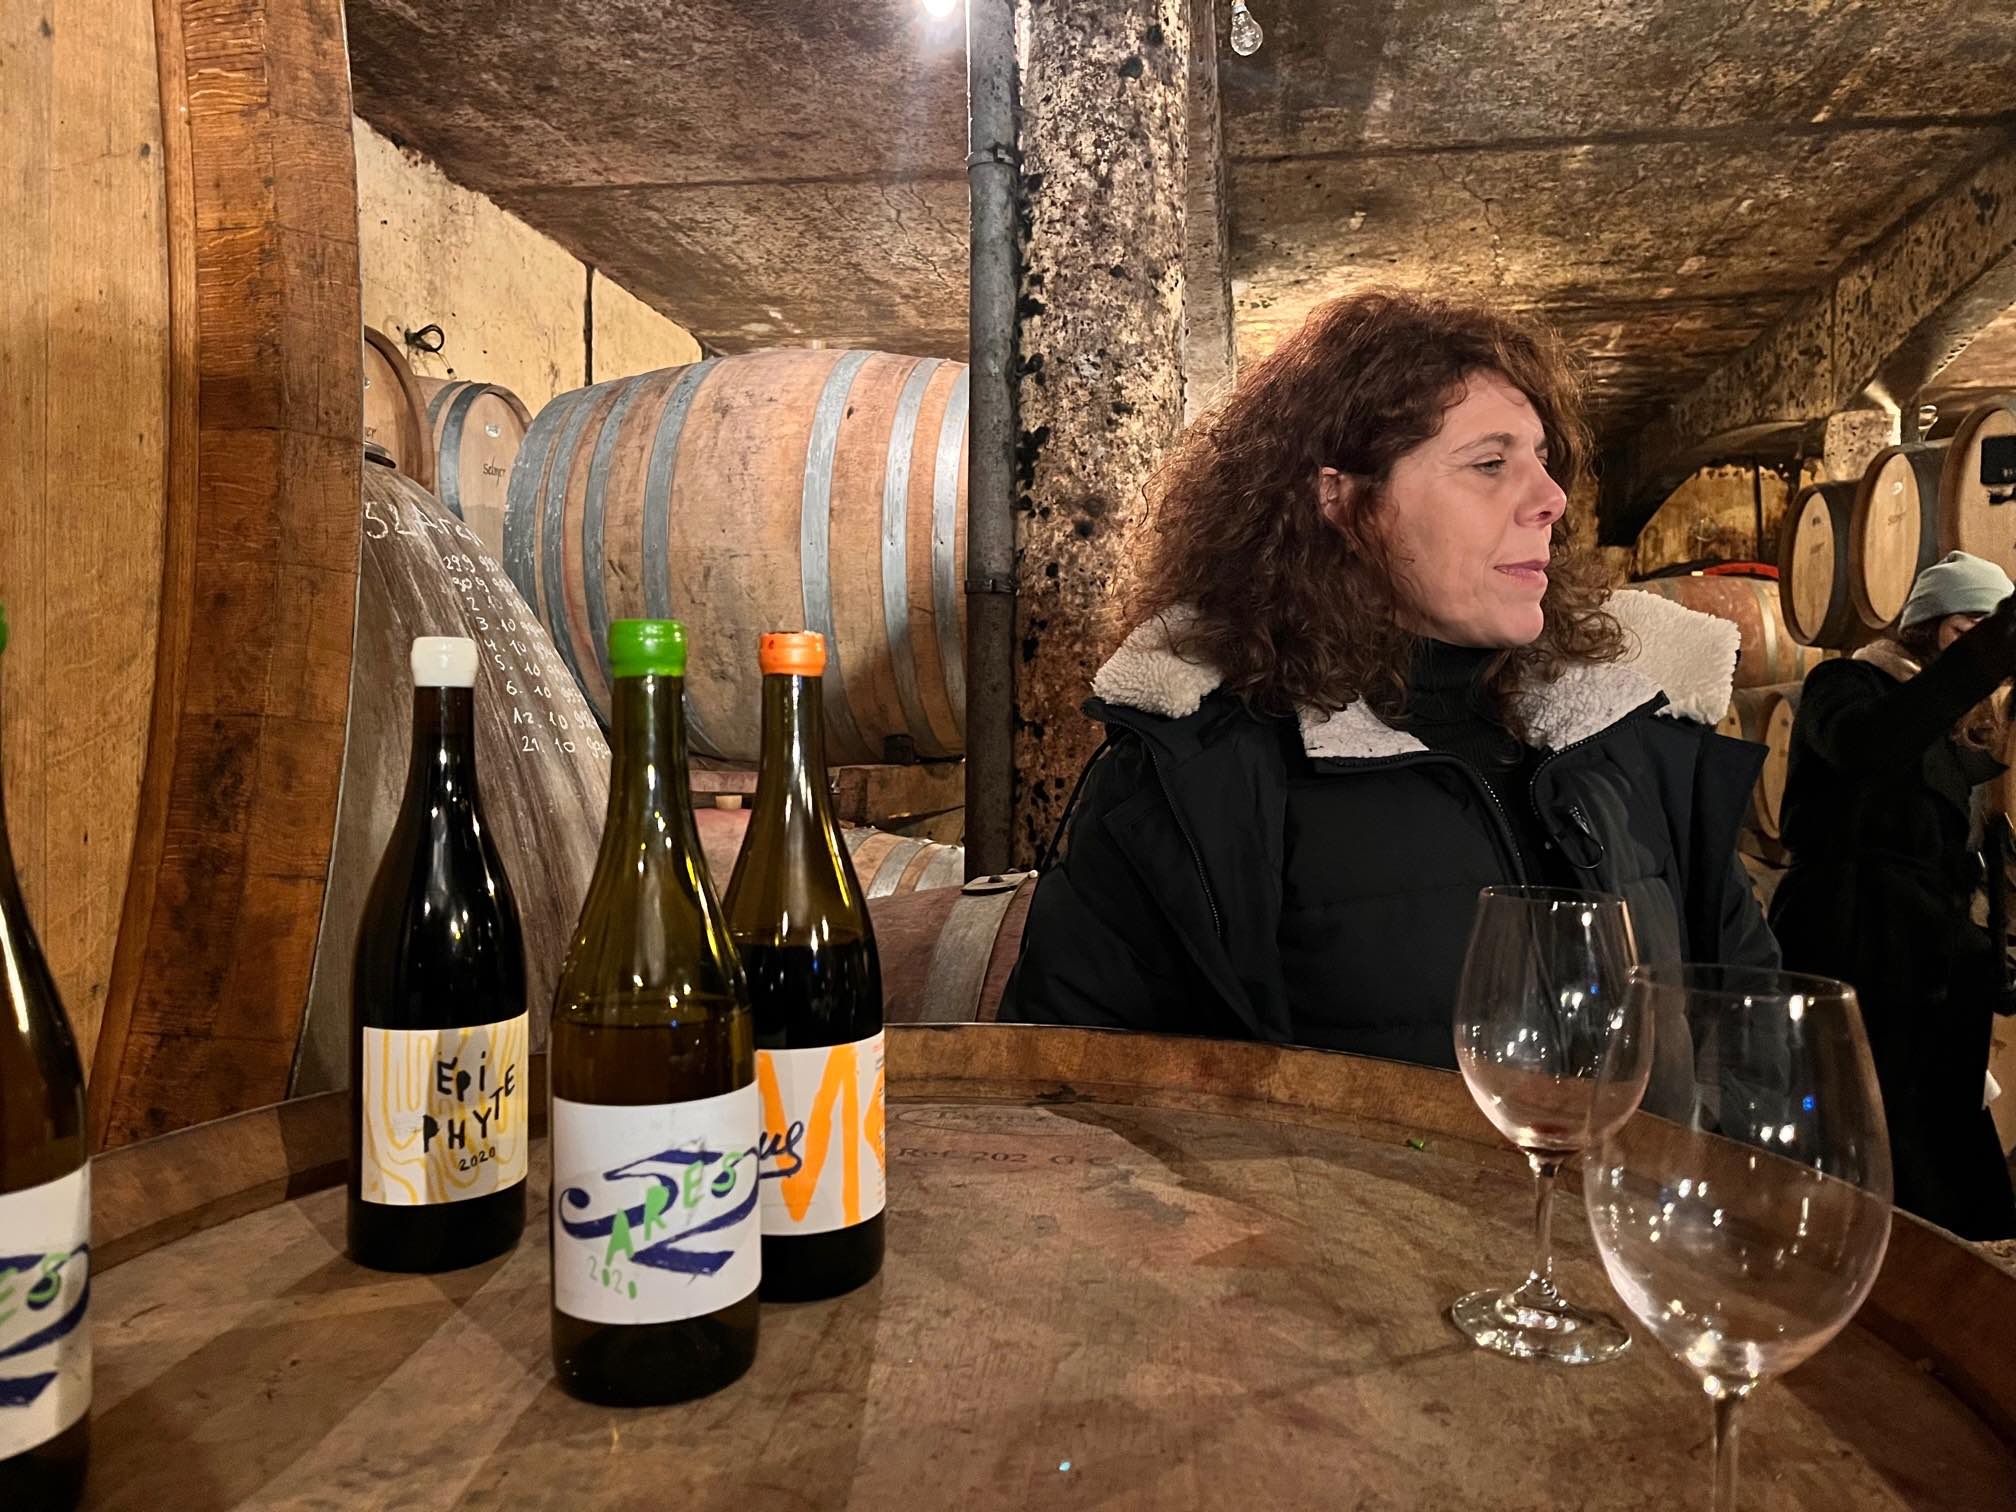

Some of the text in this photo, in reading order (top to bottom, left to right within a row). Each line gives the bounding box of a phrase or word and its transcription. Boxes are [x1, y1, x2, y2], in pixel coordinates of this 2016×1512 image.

[365, 501, 418, 539] 52
[422, 1063, 516, 1154] PHYTE
[458, 1146, 497, 1172] 2020
